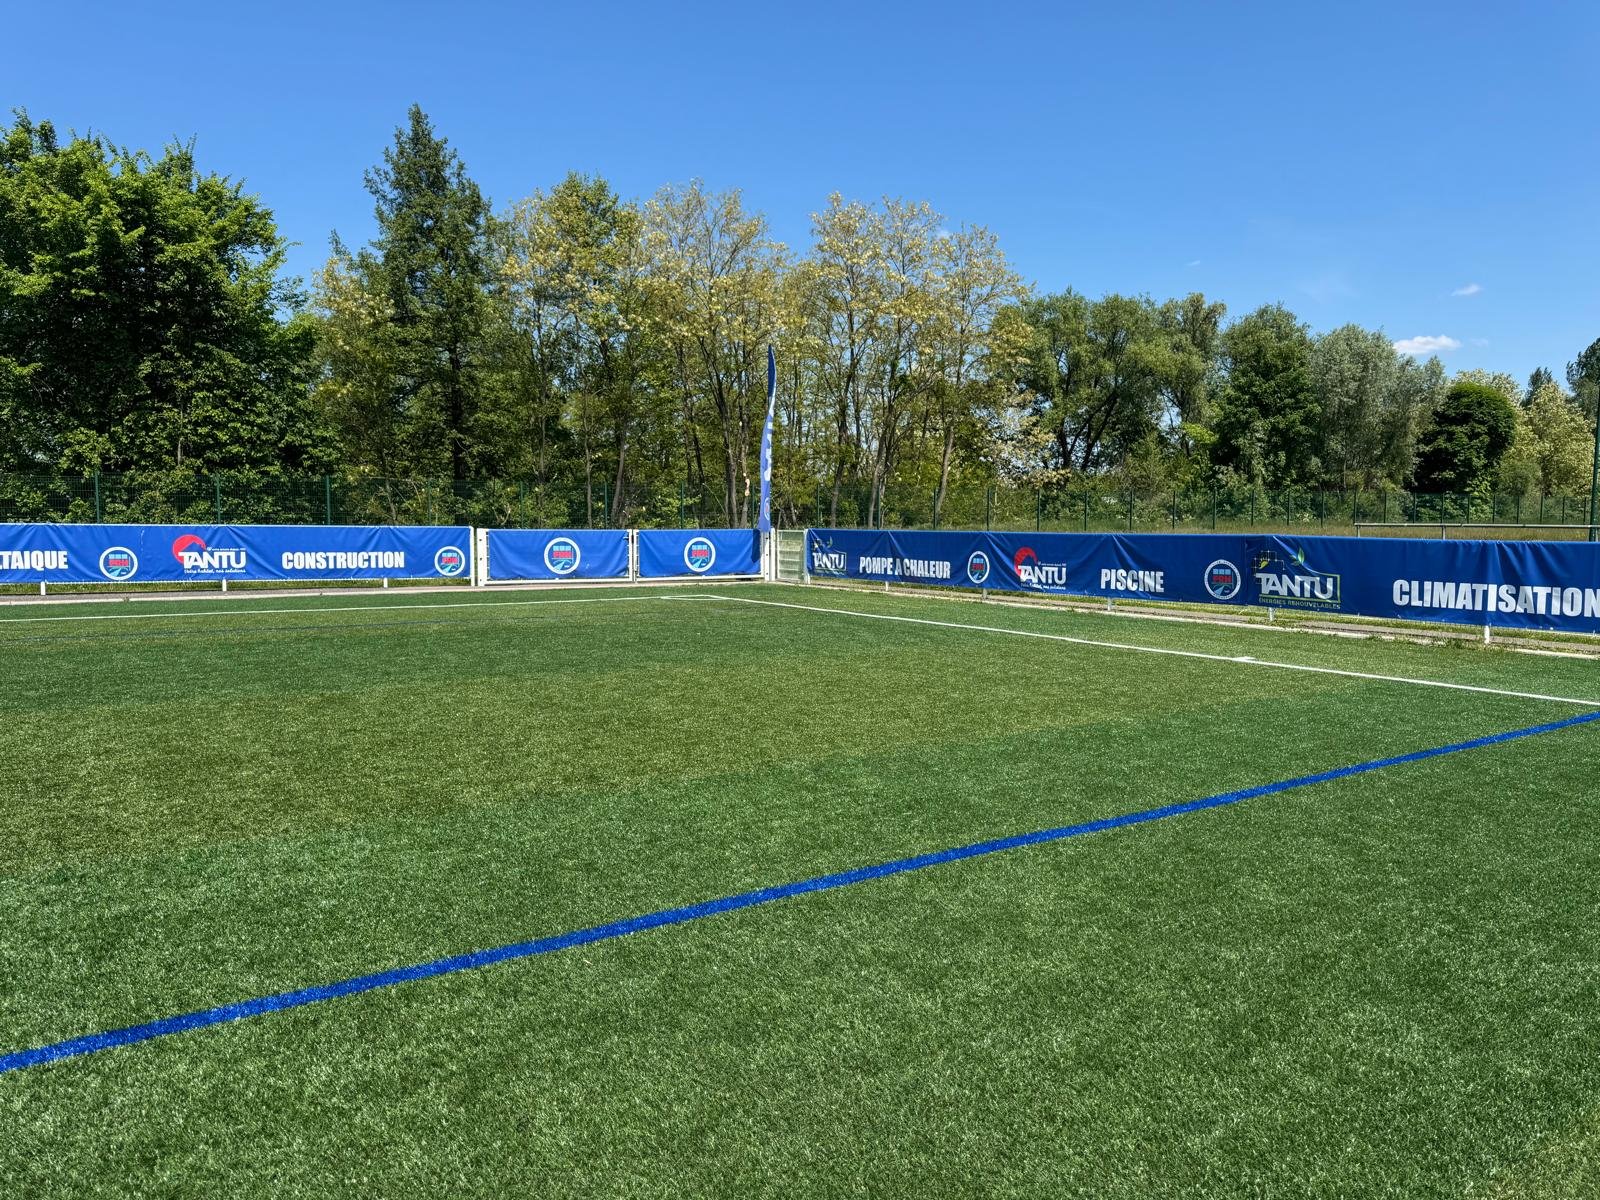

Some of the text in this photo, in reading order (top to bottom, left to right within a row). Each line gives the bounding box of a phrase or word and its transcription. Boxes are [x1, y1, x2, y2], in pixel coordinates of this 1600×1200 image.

[0, 550, 68, 571] TAIQUE
[178, 551, 247, 569] TANTU
[282, 551, 404, 569] CONSTRUCTION
[812, 552, 845, 569] TANTU
[859, 557, 893, 575] POMPE
[903, 558, 951, 579] CHALEUR
[1018, 565, 1067, 585] TANTU
[1100, 568, 1165, 593] PISCINE
[1256, 572, 1333, 600] TANTU
[1392, 579, 1600, 618] CLIMATISATION
